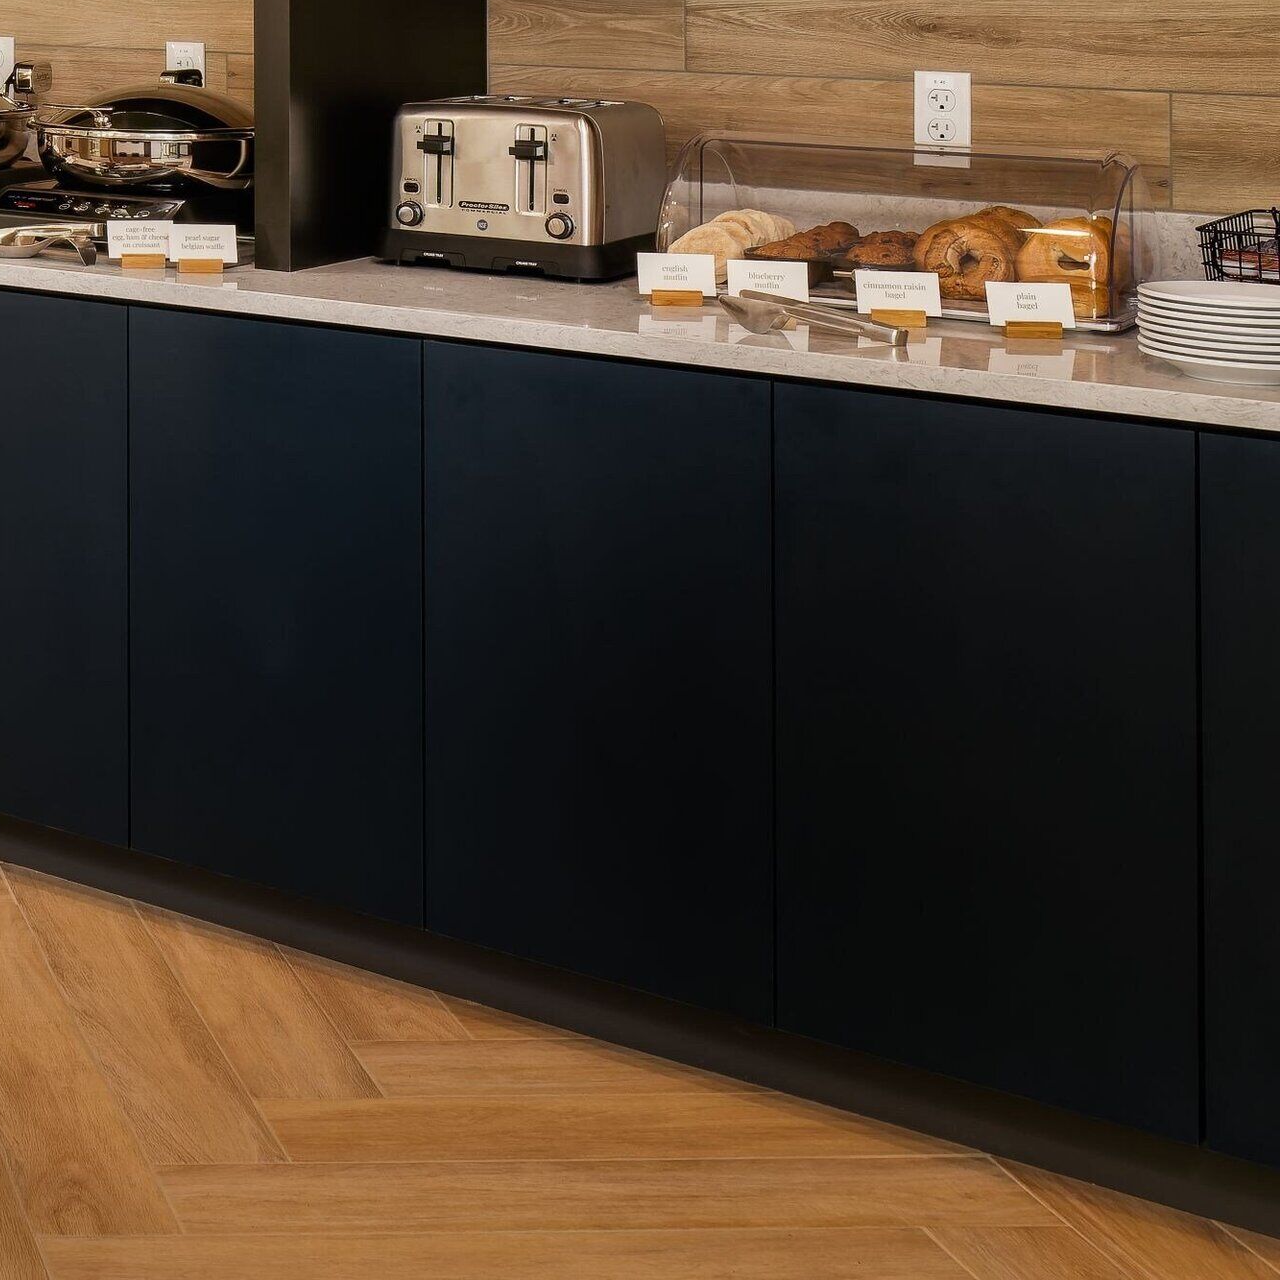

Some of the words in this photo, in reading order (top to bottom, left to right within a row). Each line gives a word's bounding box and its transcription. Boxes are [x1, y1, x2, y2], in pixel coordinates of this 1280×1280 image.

[661, 264, 689, 273] english
[663, 273, 688, 281] muffin
[748, 272, 786, 282] blueberry
[754, 281, 780, 289] muffin
[863, 281, 903, 290] cinnamon
[903, 281, 927, 291] raisin
[884, 291, 906, 300] bagel
[1016, 292, 1037, 302] plain
[1016, 301, 1039, 310] bagel
